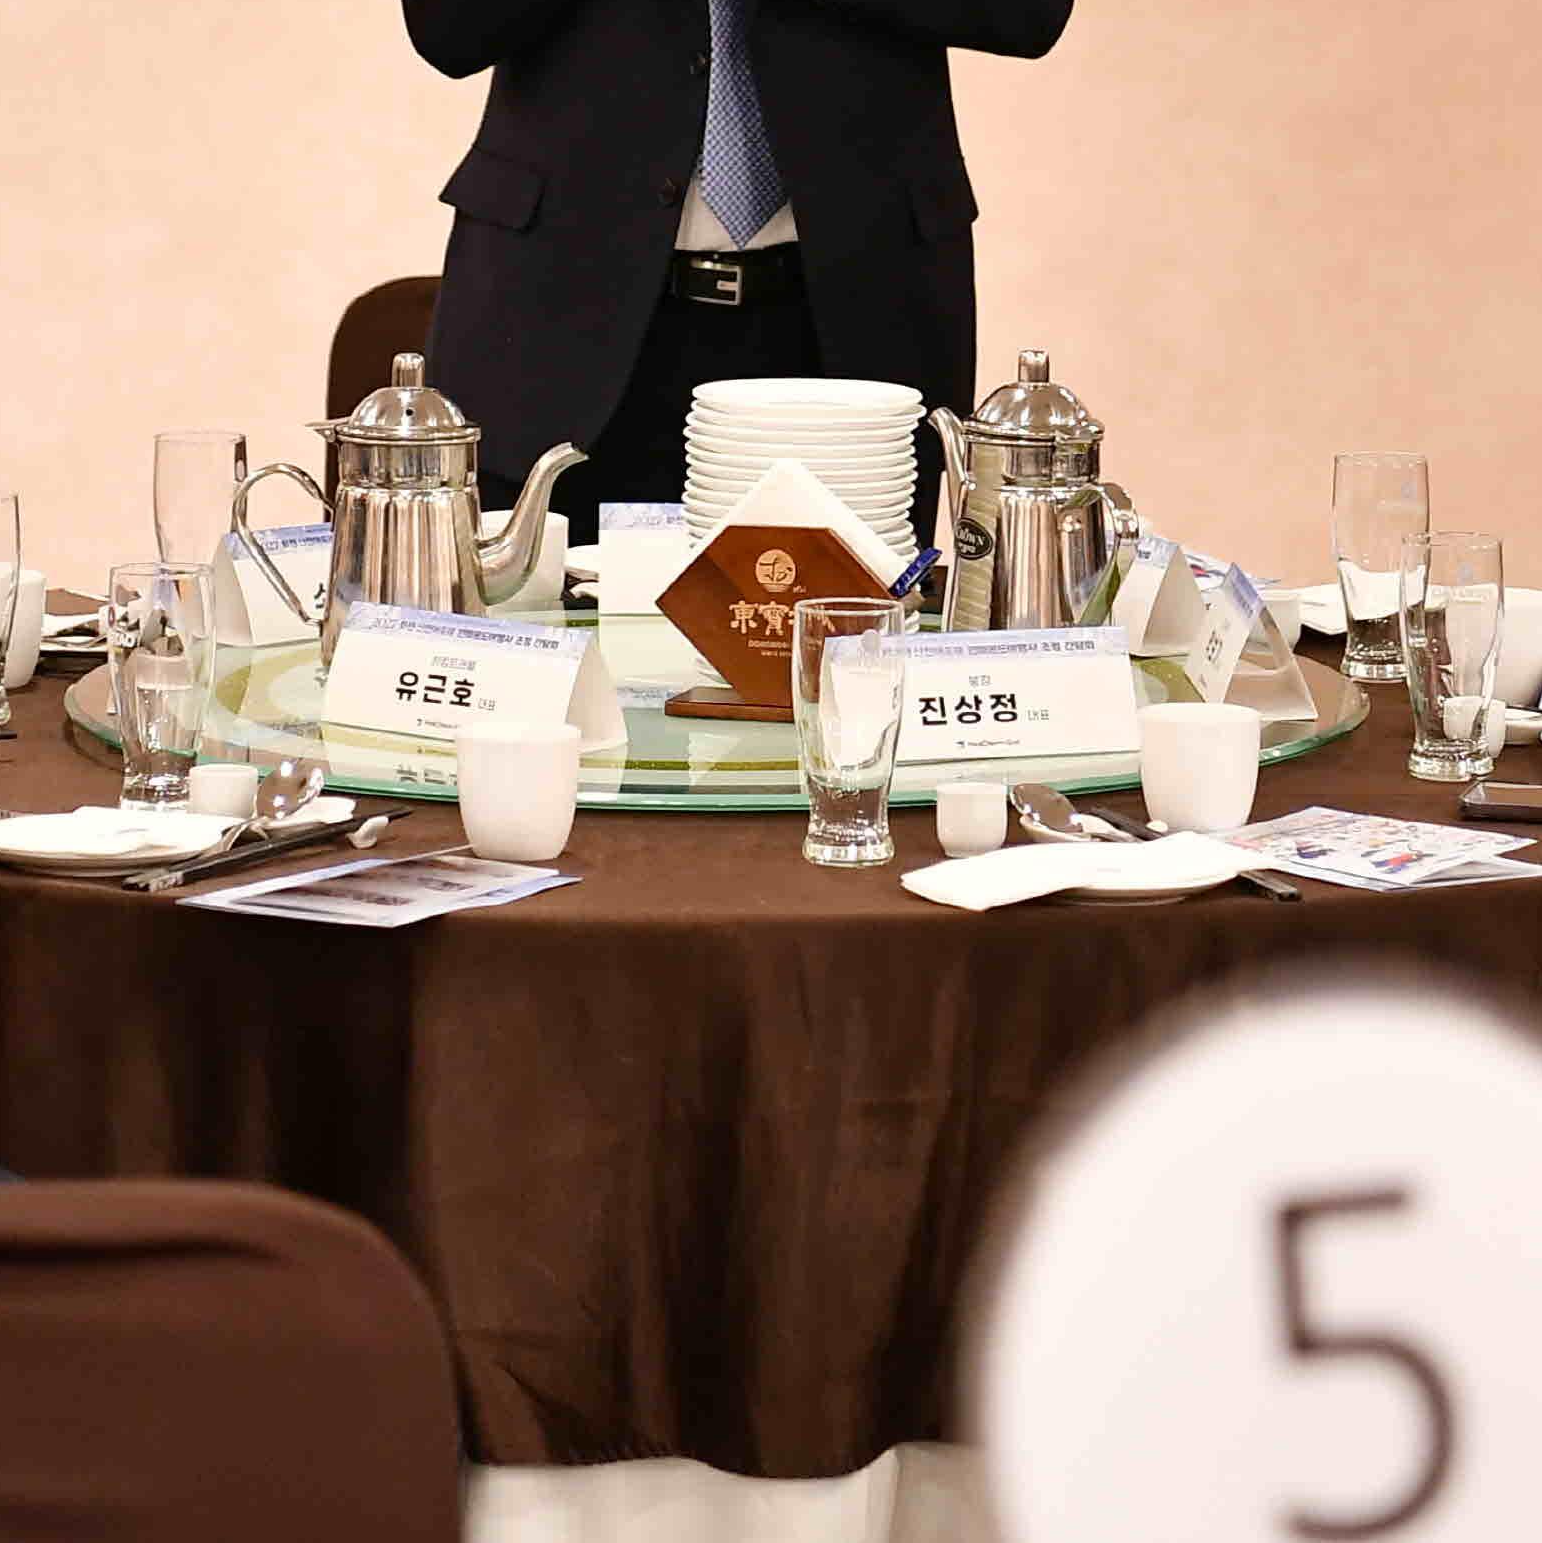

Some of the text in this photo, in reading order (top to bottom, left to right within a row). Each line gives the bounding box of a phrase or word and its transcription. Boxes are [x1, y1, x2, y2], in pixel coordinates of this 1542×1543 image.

[395, 671, 476, 708] 유근호
[917, 693, 1019, 727] 진상정
[1275, 1184, 1461, 1543] 5
